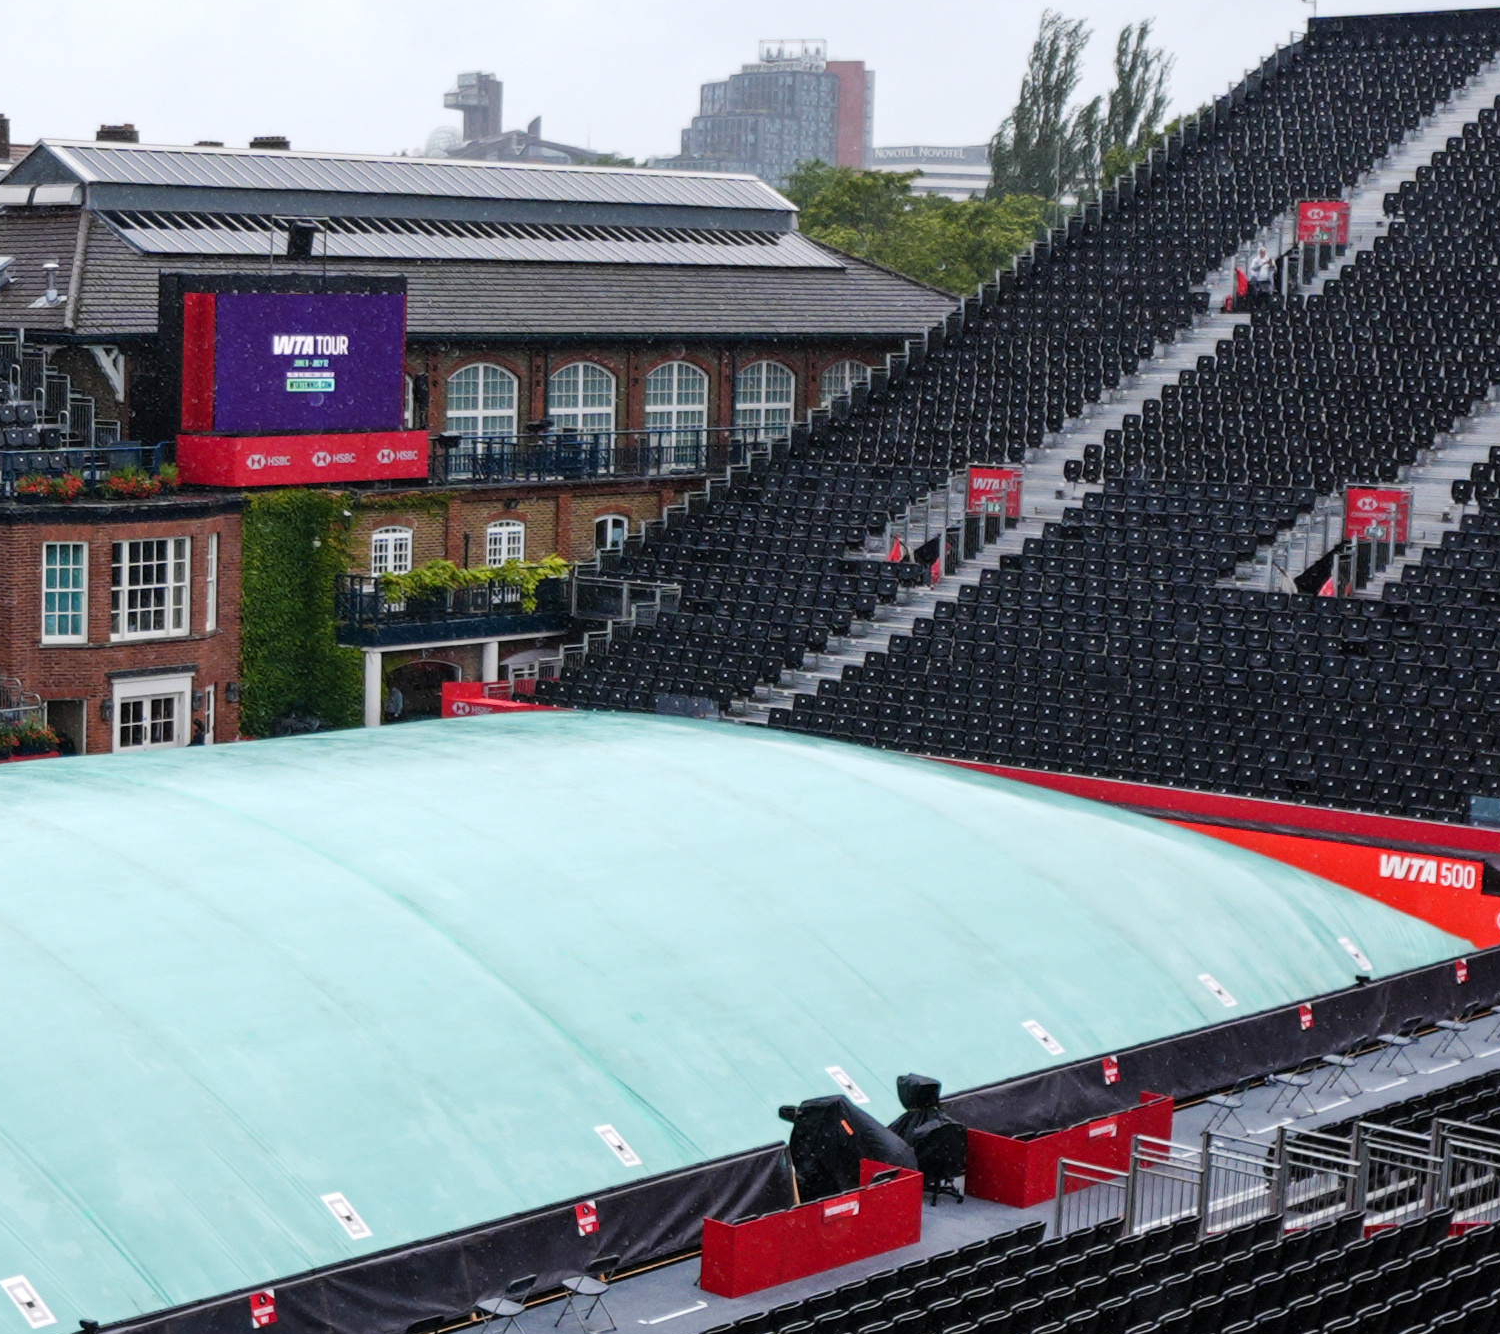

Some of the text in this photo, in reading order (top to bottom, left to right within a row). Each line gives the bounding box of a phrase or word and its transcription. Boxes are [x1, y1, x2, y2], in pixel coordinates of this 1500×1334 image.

[874, 147, 966, 159] NOVOTEL NOVOTEL
[273, 335, 349, 355] WTA TOUR
[268, 456, 291, 466] HSBC
[333, 453, 356, 463] HSBC
[396, 450, 418, 461] HSBC
[1379, 853, 1476, 890] WTA 500
